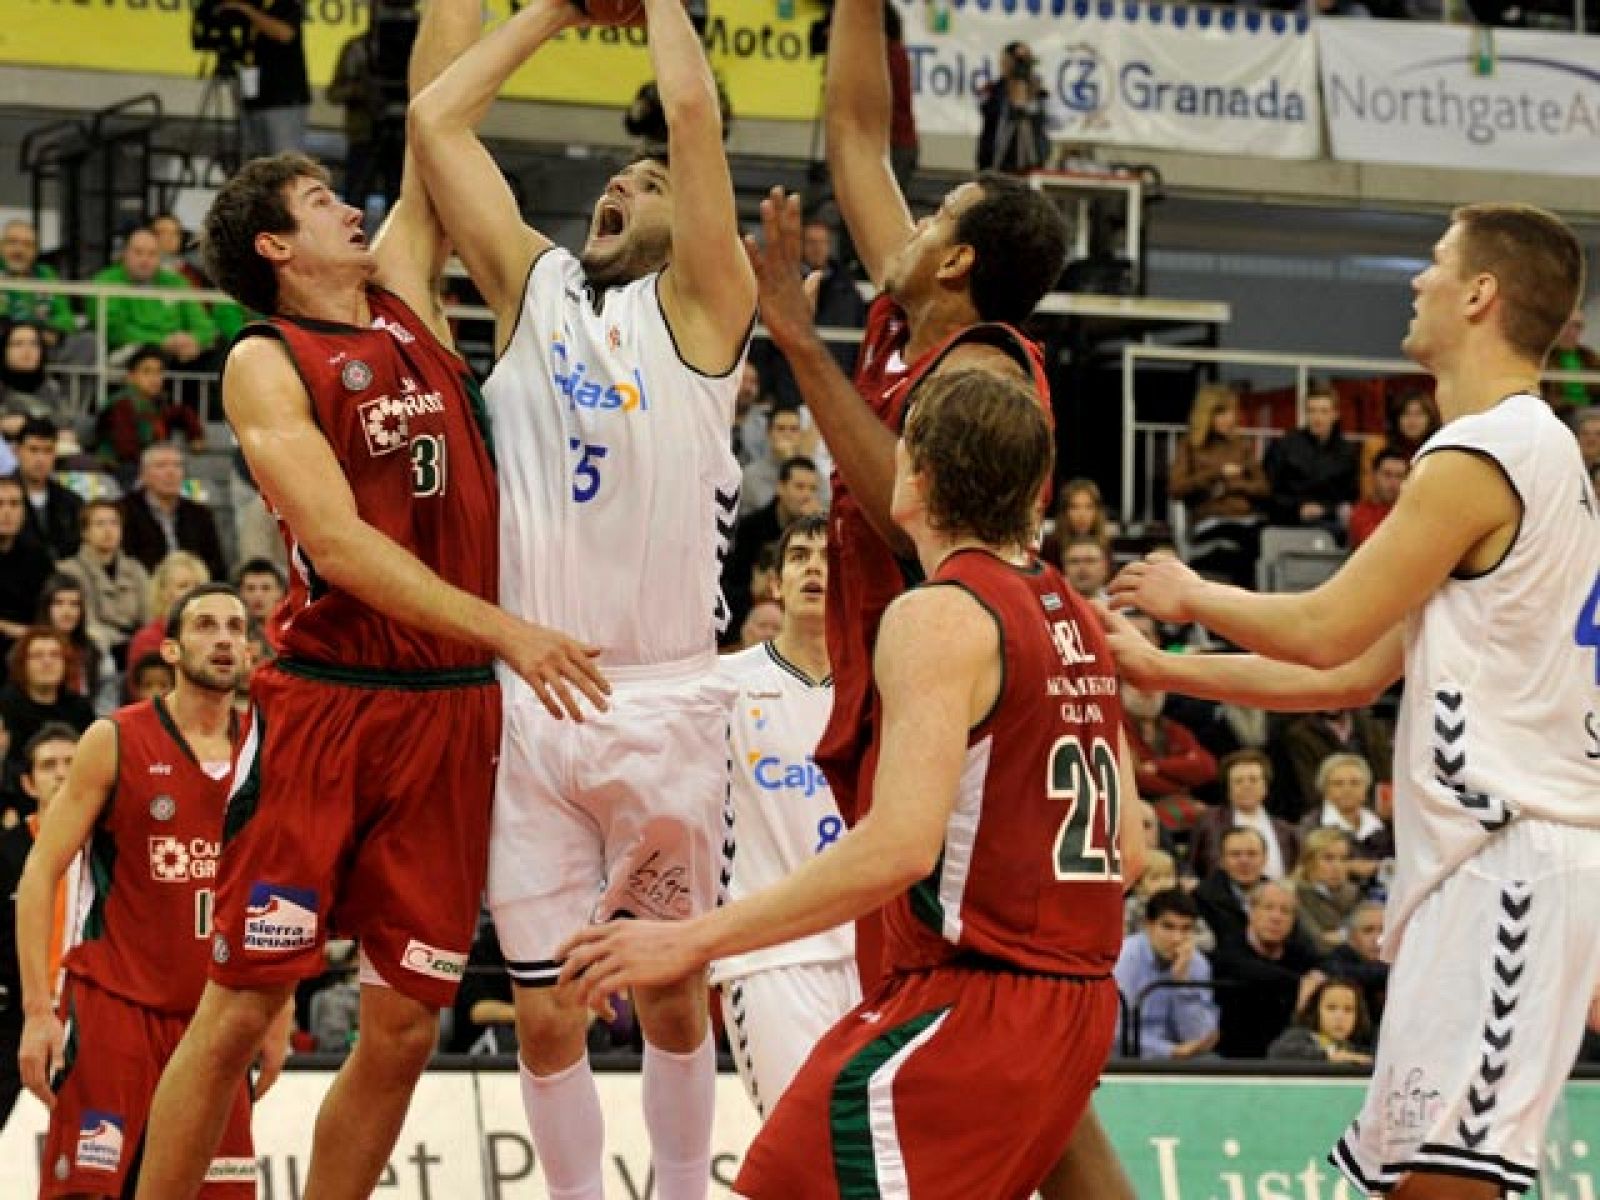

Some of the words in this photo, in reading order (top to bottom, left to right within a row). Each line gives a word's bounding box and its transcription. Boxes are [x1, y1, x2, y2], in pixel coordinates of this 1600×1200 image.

[908, 46, 994, 98] Told
[1119, 61, 1306, 122] Granada
[1329, 72, 1600, 146] NorthgateA
[248, 919, 304, 936] sierra
